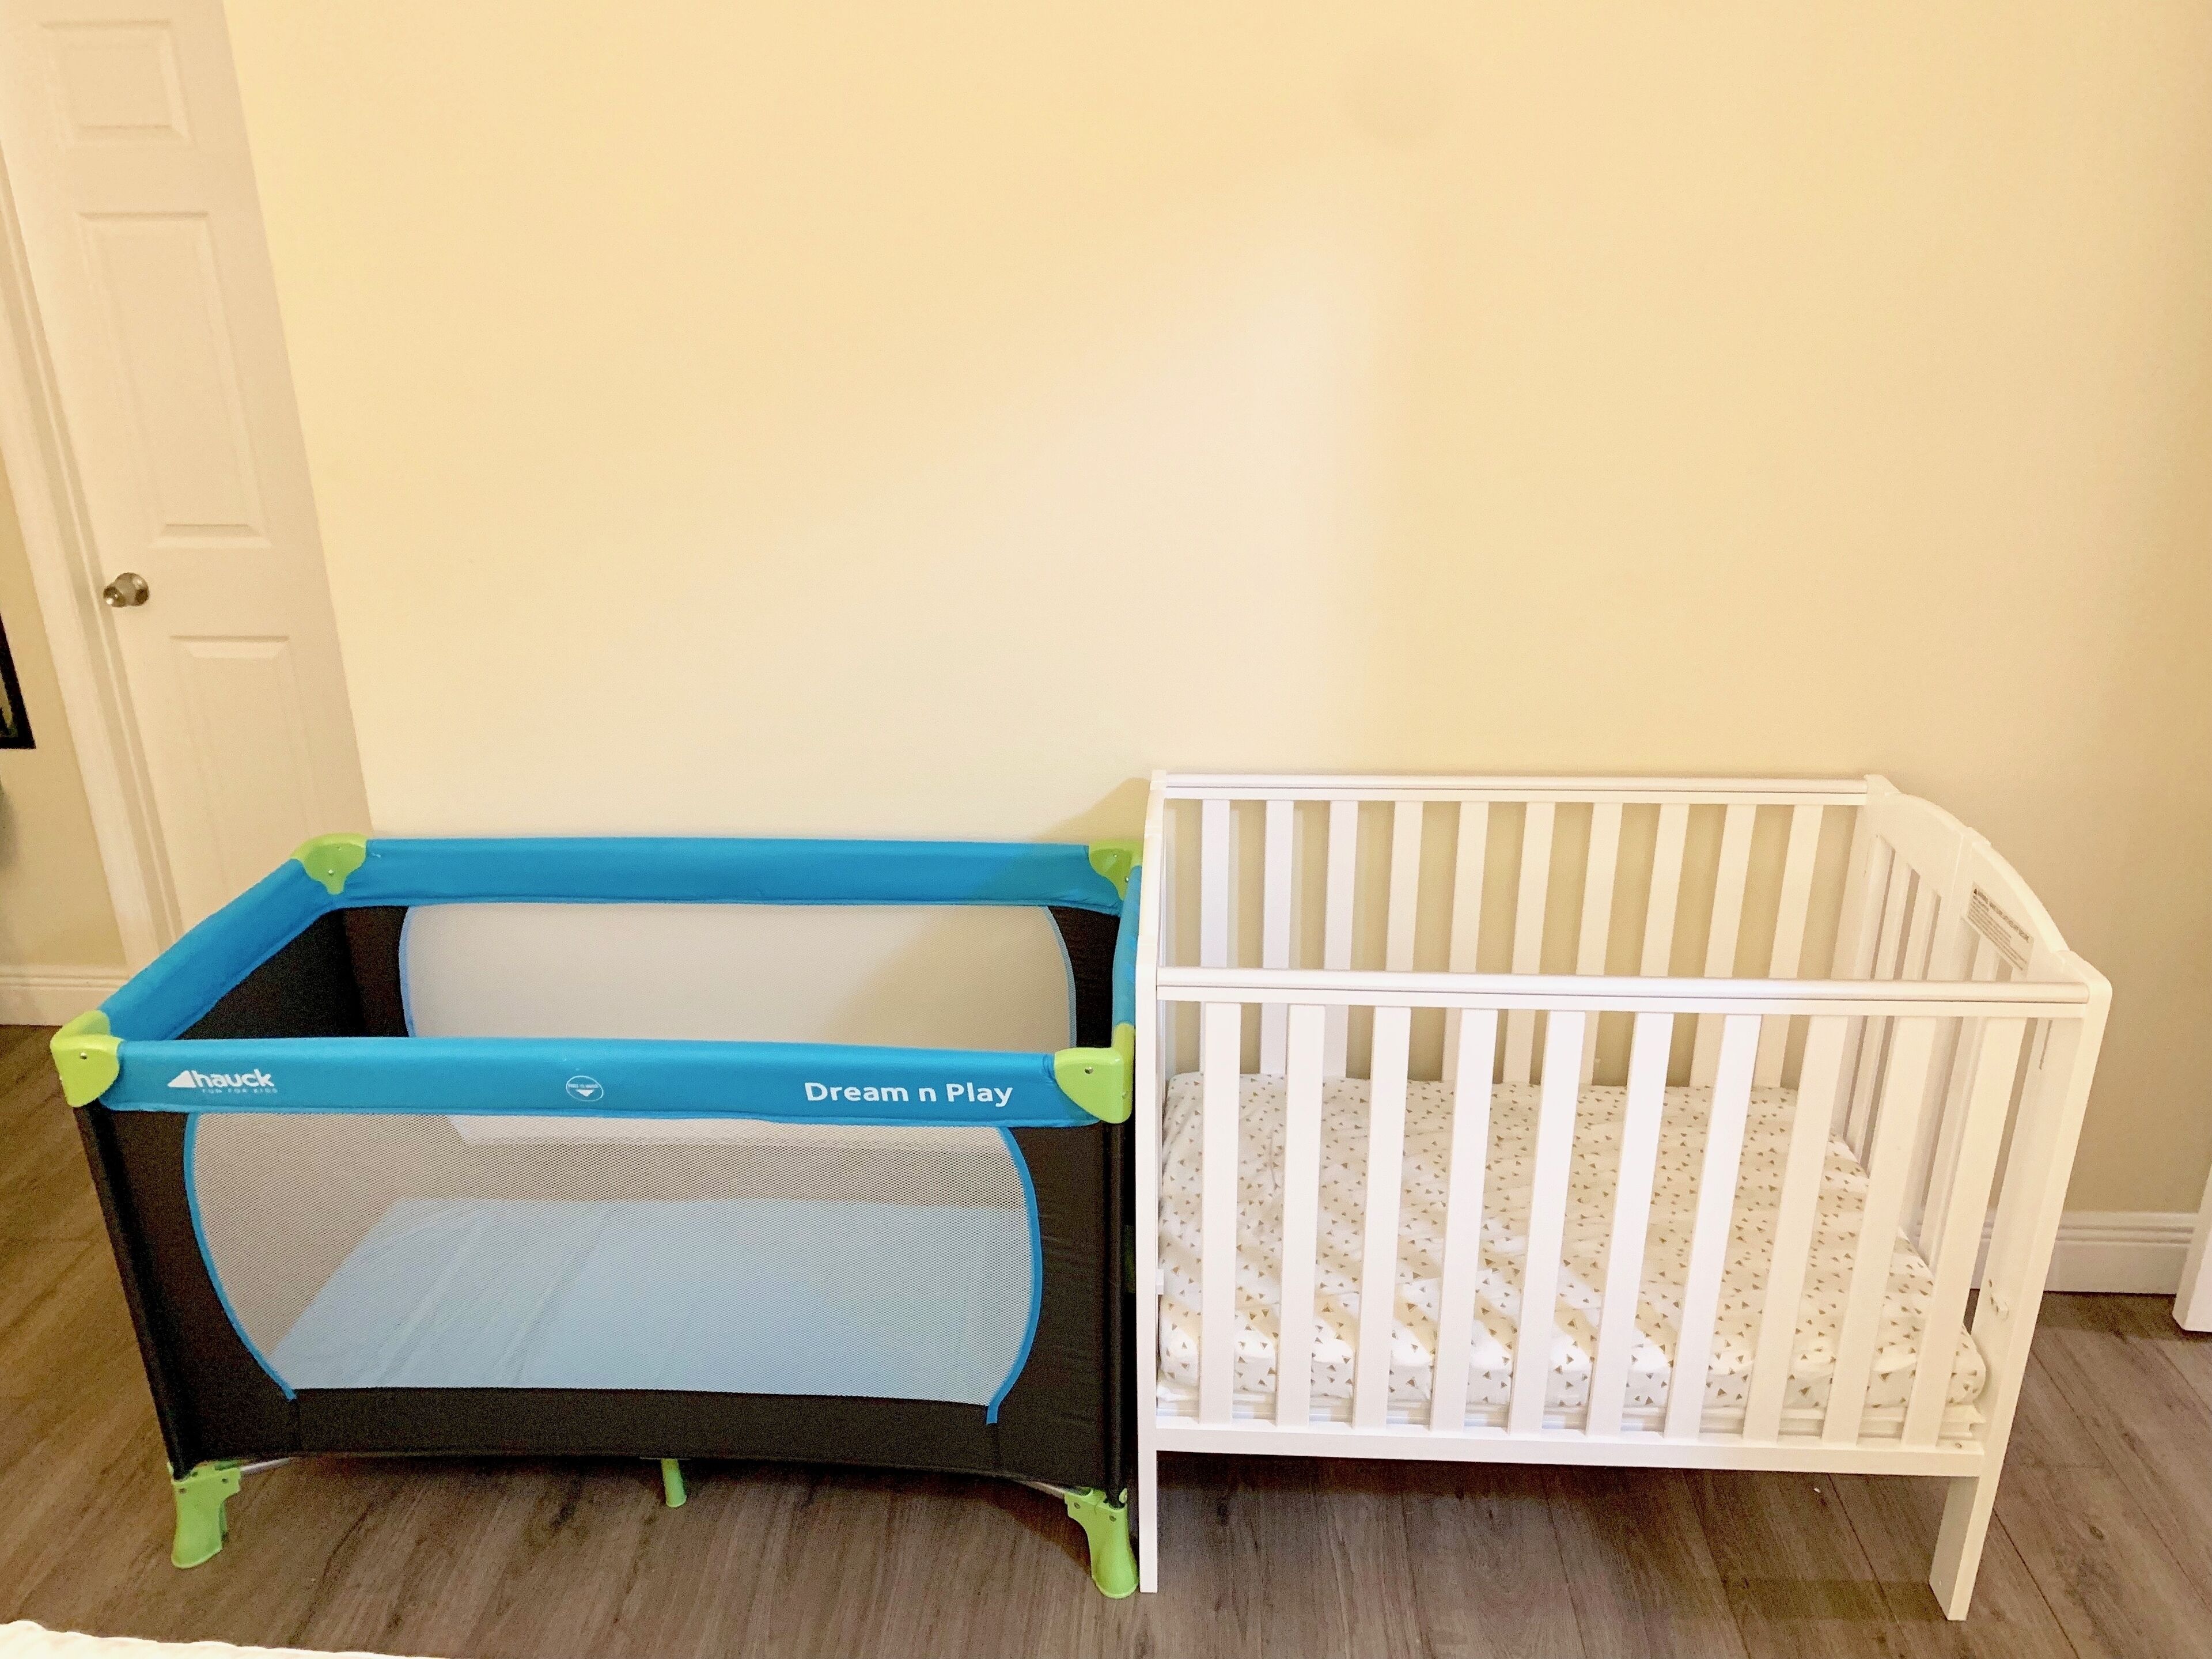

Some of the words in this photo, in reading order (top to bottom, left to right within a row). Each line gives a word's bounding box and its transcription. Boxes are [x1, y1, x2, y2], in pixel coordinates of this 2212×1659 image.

[191, 1069, 274, 1088] hauck
[804, 1082, 909, 1102] Dream
[919, 1087, 937, 1102] n
[946, 1082, 1013, 1108] Play
